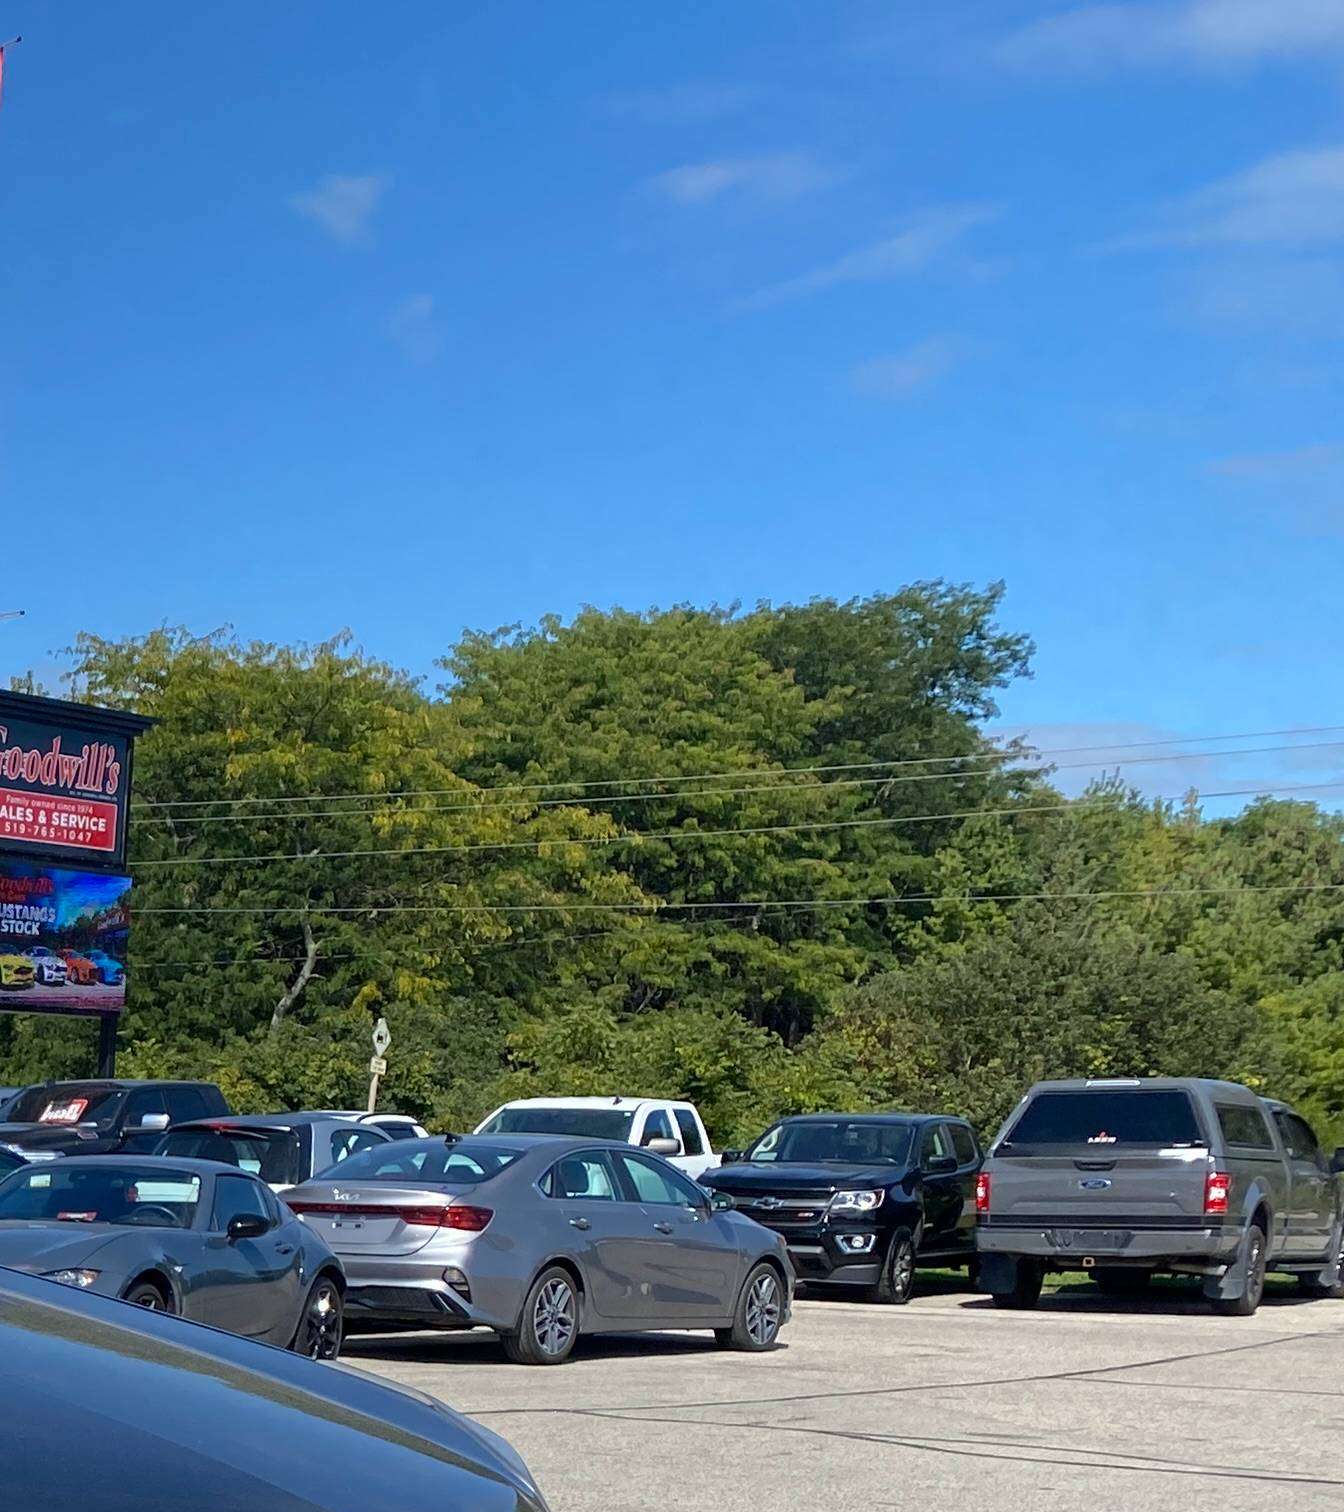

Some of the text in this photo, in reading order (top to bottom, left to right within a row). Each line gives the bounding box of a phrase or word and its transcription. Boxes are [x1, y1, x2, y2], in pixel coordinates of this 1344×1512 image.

[6, 795, 30, 806] Family
[32, 800, 55, 808] owned
[57, 802, 75, 812] since
[38, 811, 47, 824] &
[52, 813, 107, 832] SERVICE
[5, 822, 92, 842] 519-765-1047
[1, 920, 40, 935] STOCK
